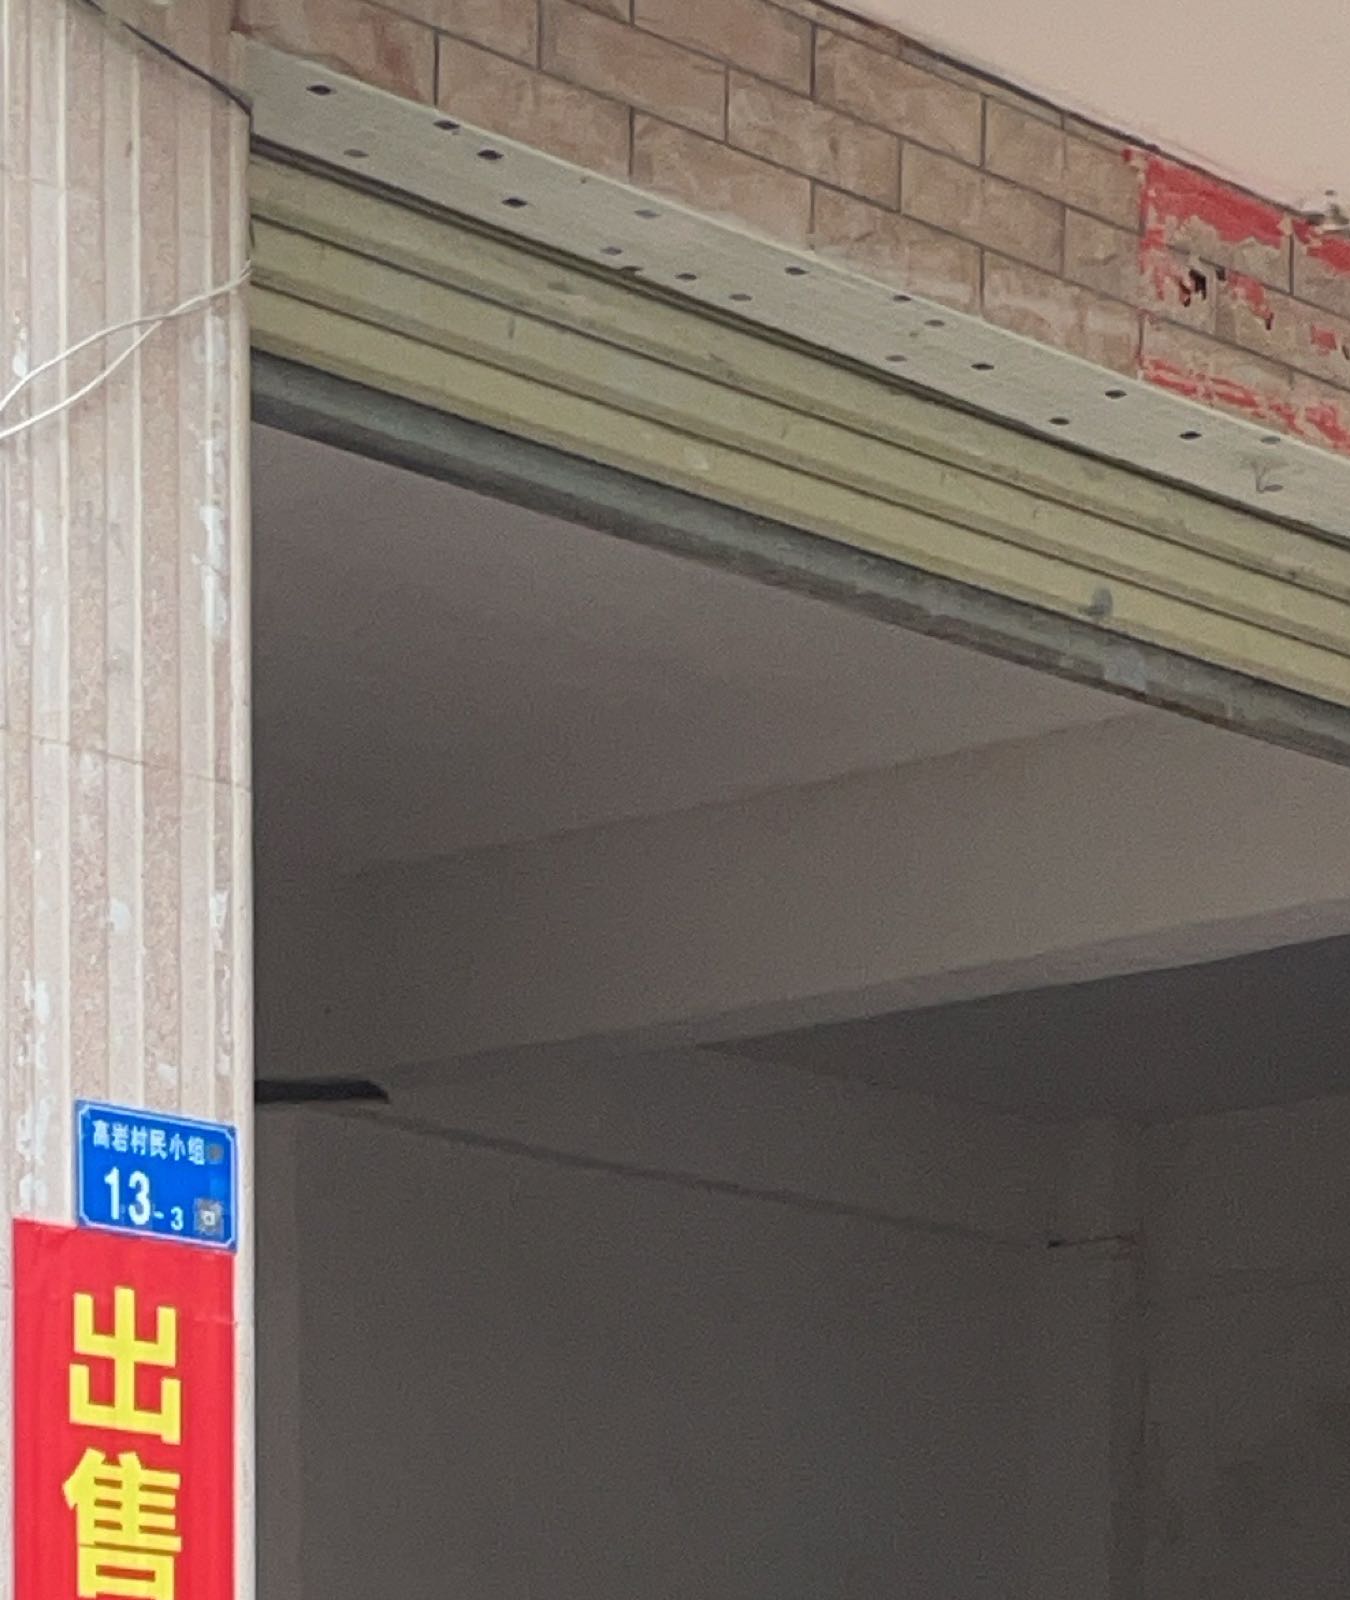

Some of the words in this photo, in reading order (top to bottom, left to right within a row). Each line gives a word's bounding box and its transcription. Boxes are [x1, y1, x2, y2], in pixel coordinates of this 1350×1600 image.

[92, 1119, 205, 1166] 高岩村民小组
